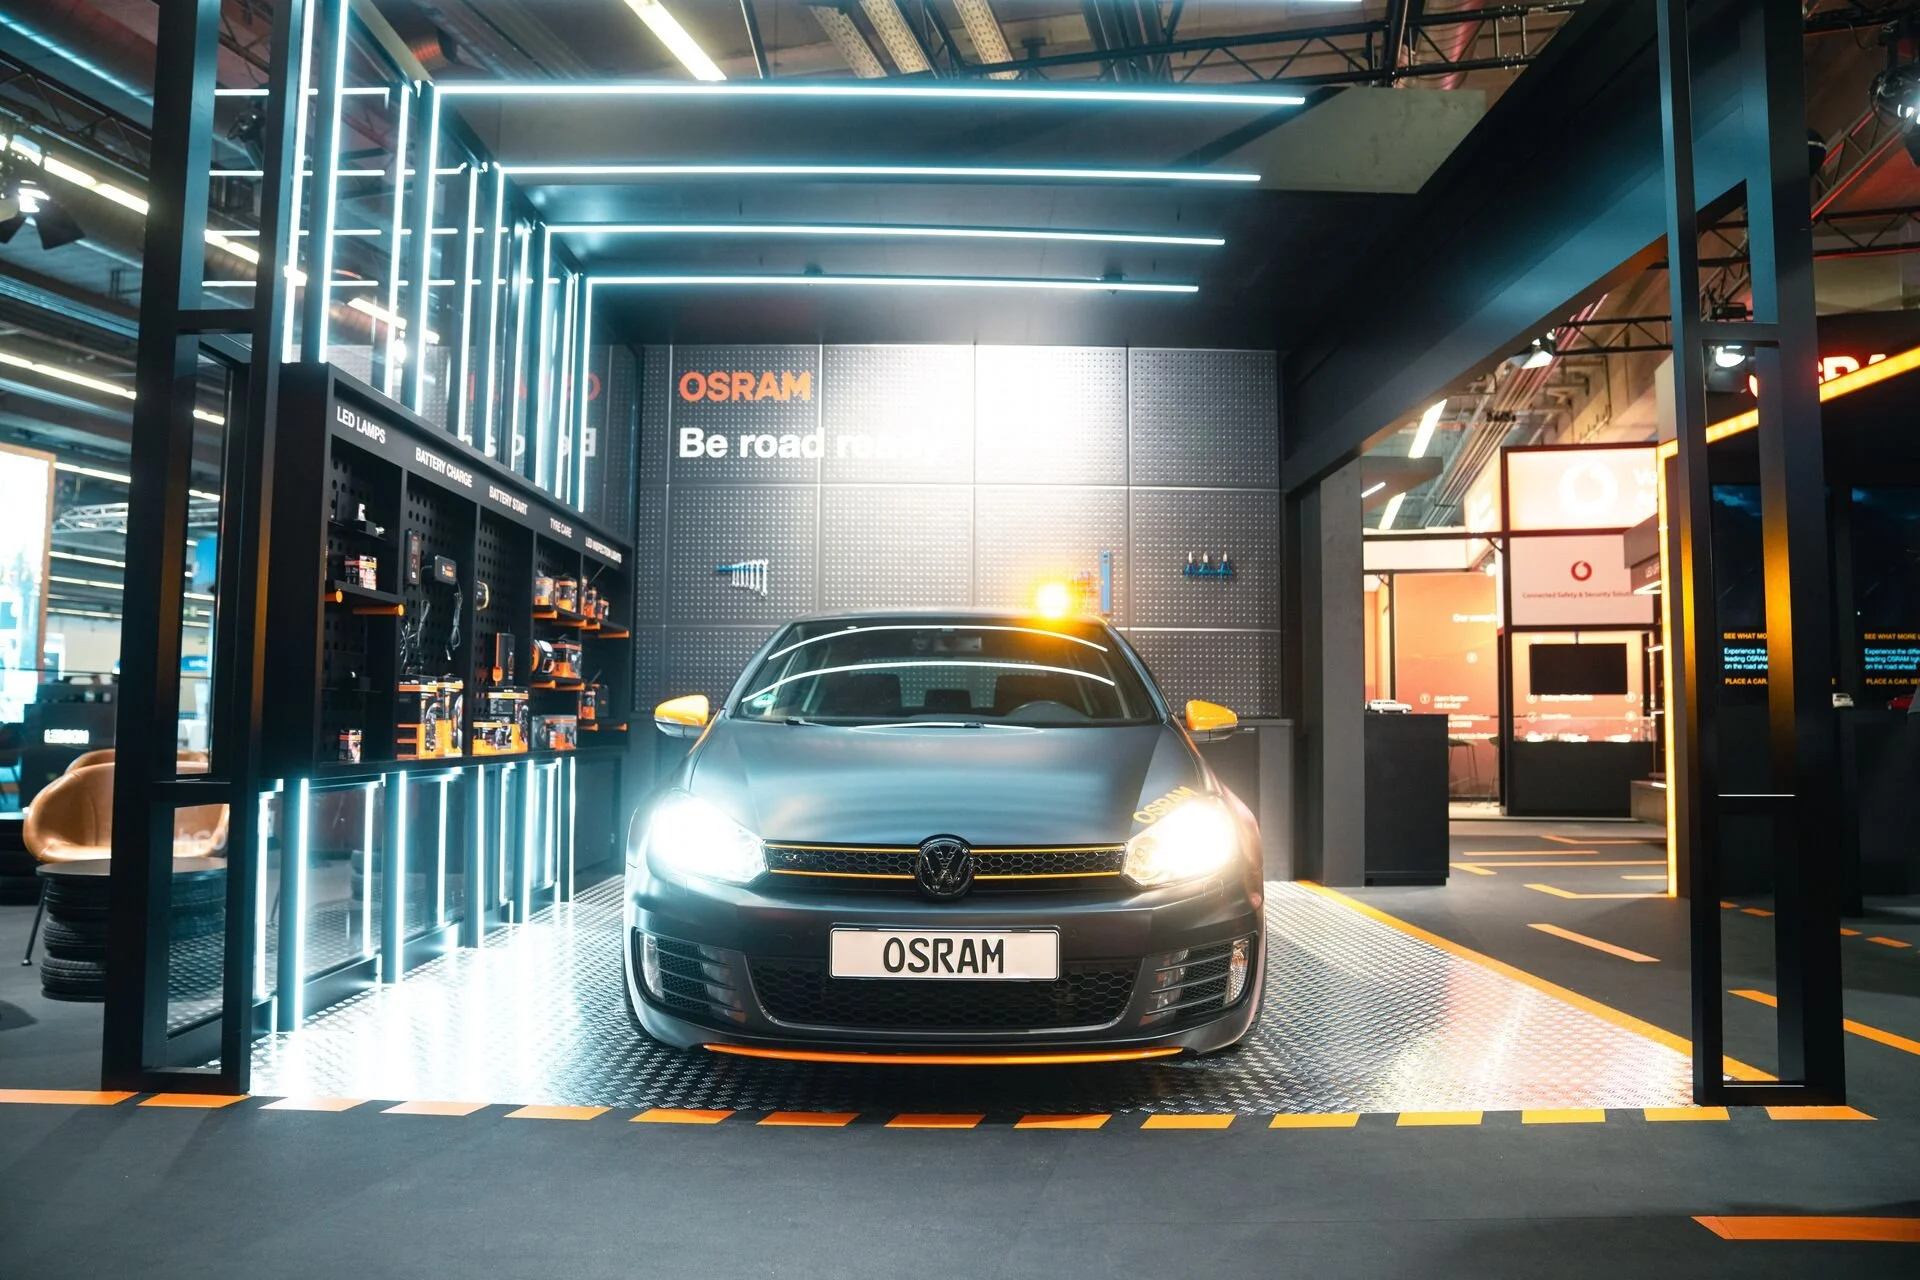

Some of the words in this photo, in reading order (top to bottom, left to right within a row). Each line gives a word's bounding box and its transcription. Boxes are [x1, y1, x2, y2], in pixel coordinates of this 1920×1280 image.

[679, 371, 812, 401] OSRAM
[336, 405, 356, 429] LED
[356, 415, 387, 445] LAMPS
[679, 427, 729, 458] Be
[739, 426, 825, 459] road
[415, 446, 446, 475] BATTERY
[446, 463, 473, 489] CHARGE
[489, 485, 512, 508] BATTERY
[511, 497, 529, 516] START
[1557, 591, 1577, 600] Safety
[1723, 632, 1736, 640] SEE
[1737, 632, 1756, 640] WHAT
[1757, 632, 1768, 640] MO
[1724, 647, 1756, 655] Experience
[1865, 648, 1897, 656] Experience
[1133, 785, 1199, 824] OSRAM
[883, 937, 1004, 974] OSRAM
